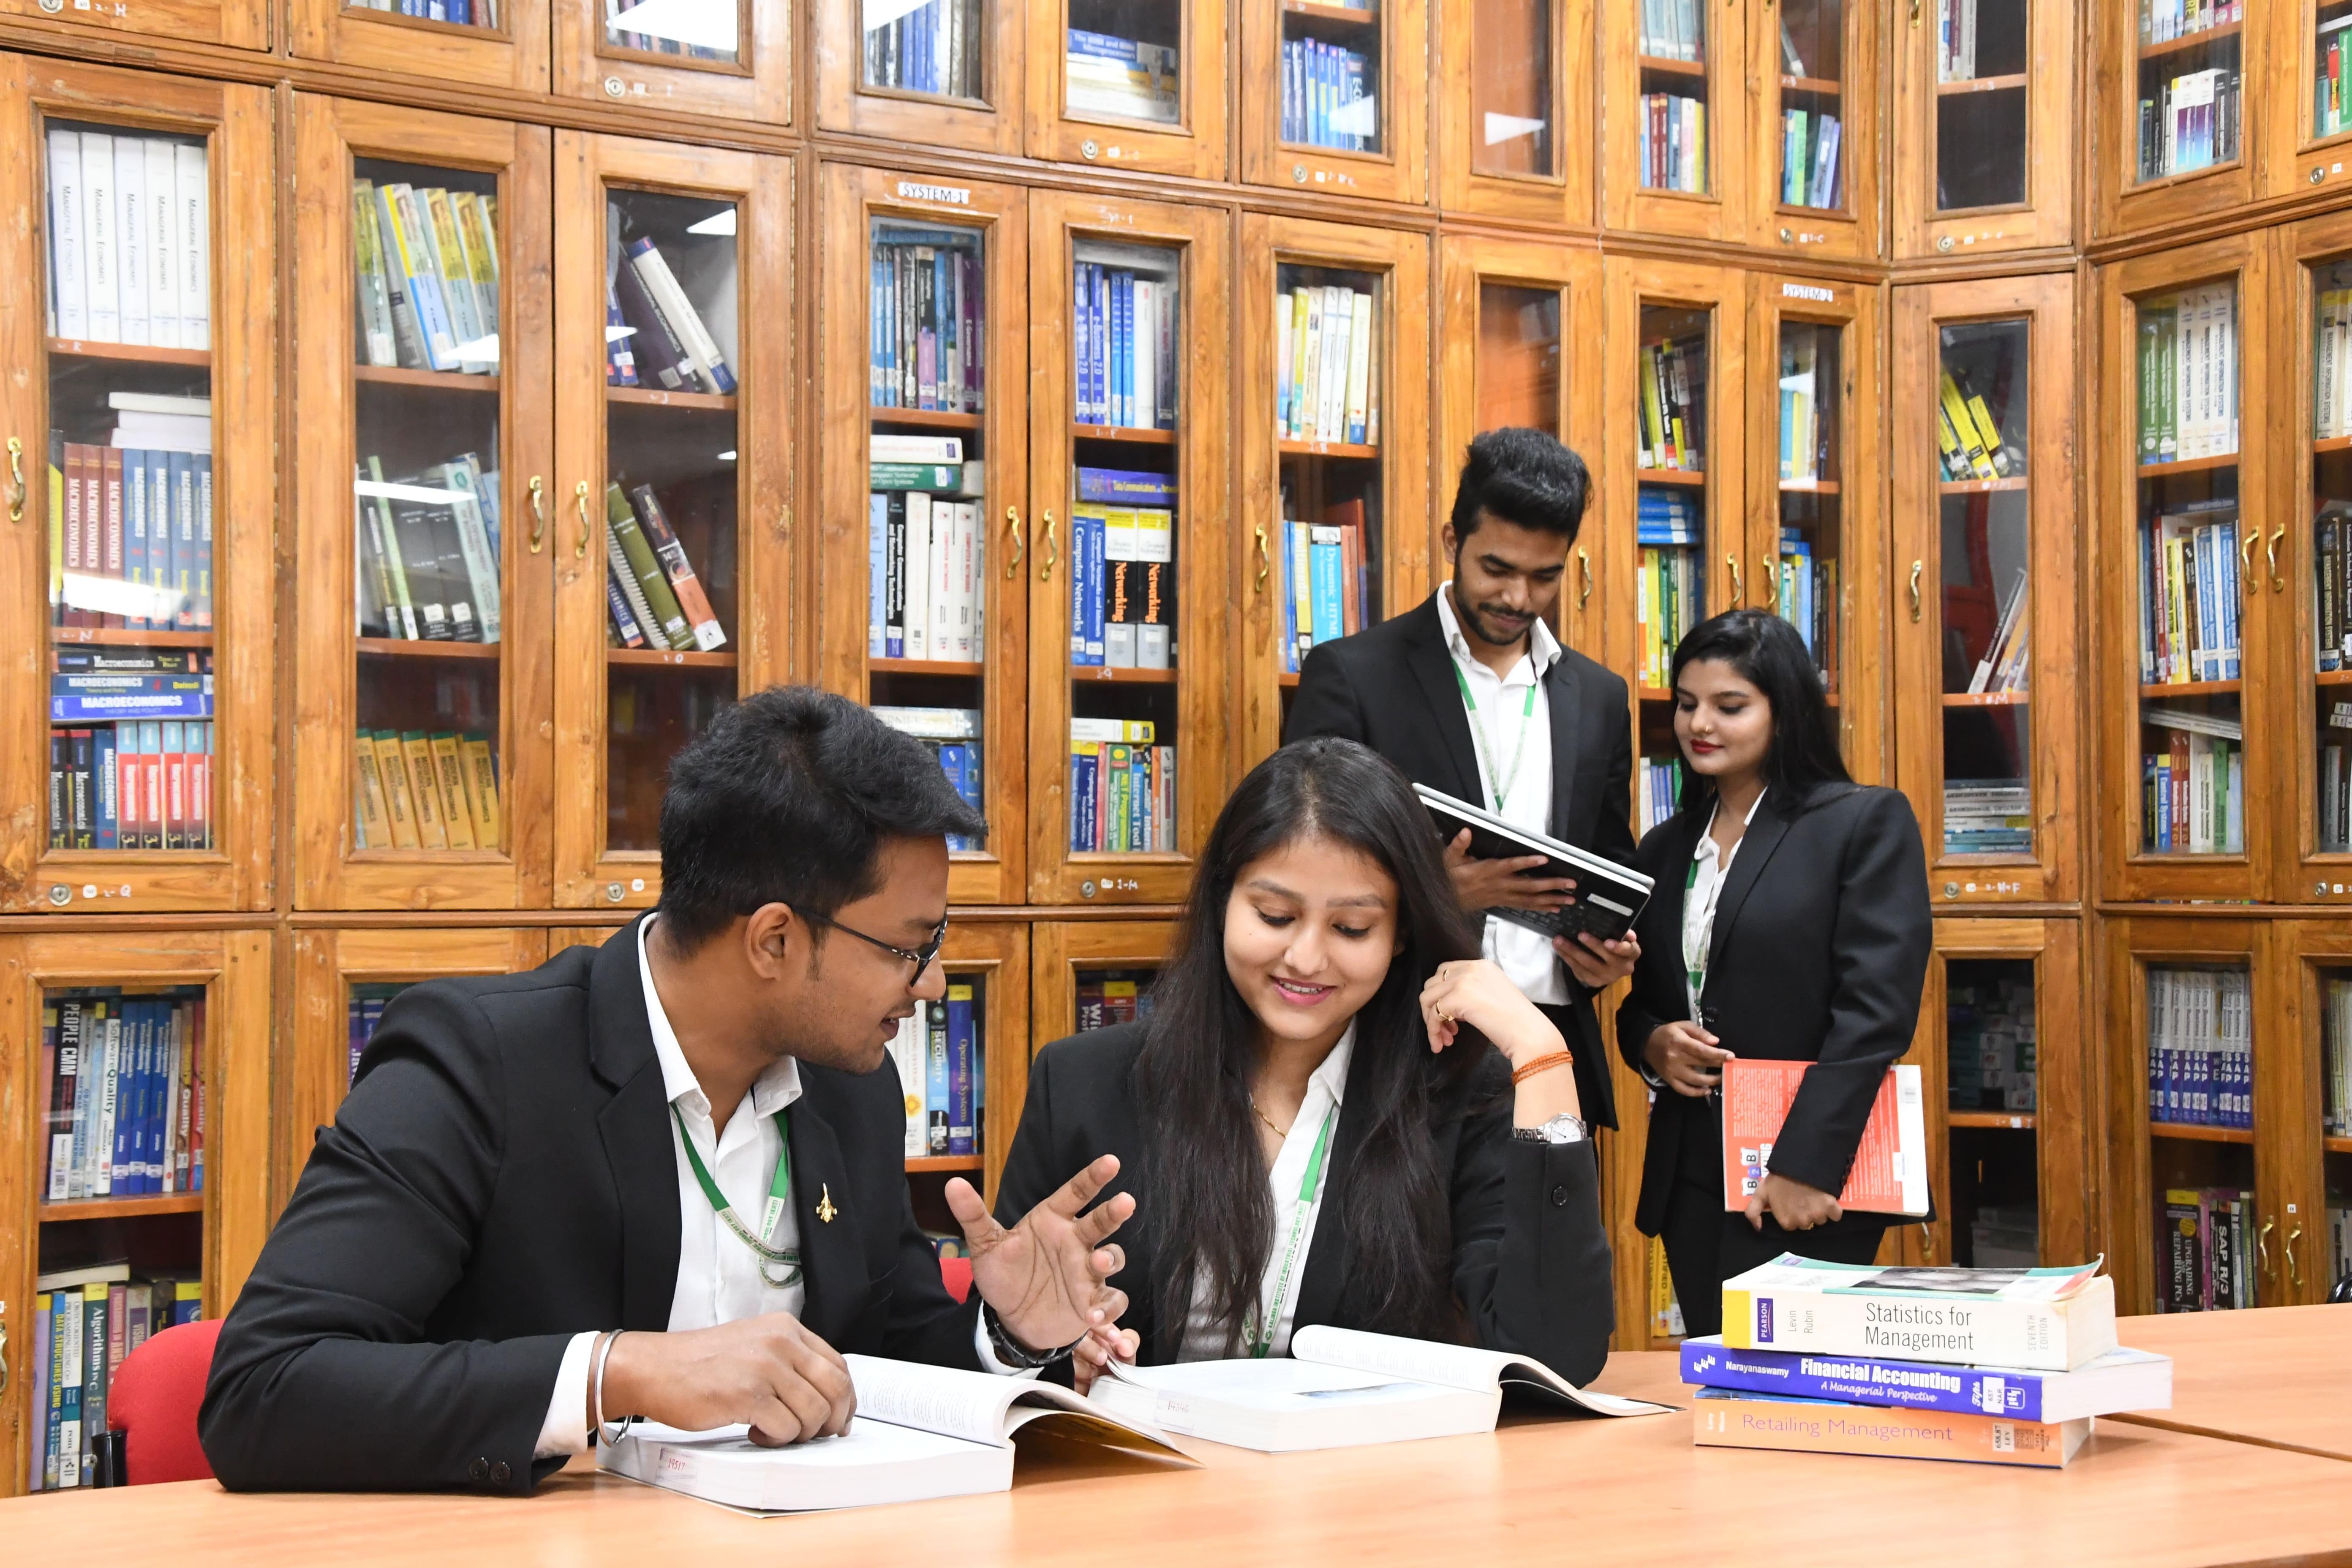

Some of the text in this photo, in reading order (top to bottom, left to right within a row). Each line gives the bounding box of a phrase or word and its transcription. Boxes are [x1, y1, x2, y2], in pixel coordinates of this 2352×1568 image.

[903, 184, 964, 202] SYSTEM-1
[68, 478, 80, 567] MACROECONOMICS
[87, 479, 99, 568] MACROECONOMICS
[109, 481, 120, 569] MACROECONOMICS
[1073, 527, 1085, 632] Computer Networks
[1326, 547, 1337, 597] Dynamic
[1112, 562, 1128, 622] Networking
[1145, 562, 1161, 623] Networking
[69, 678, 143, 688] MACROECONOMICS
[81, 696, 183, 708] MACROECONOMICS
[104, 748, 115, 819] MACROECONOMICS
[1132, 773, 1142, 845] Internet Tool
[62, 1004, 81, 1043] PEOPLE
[60, 1047, 77, 1075] CMM
[104, 1023, 120, 1114] Software Quality
[958, 1039, 968, 1122] Operating Systems
[762, 1216, 773, 1242] CHNOLOGY
[1268, 1308, 1277, 1328] KALINGA
[1273, 1283, 1285, 1307] INSTITUTE
[1281, 1248, 1293, 1274] INDUSTRIAL
[1289, 1216, 1301, 1246] TECHNOLOGY
[2173, 1231, 2182, 1301] REPAIRING PCs
[2185, 1239, 2193, 1295] UPGRADING
[2219, 1225, 2229, 1294] SAP R/3
[55, 1314, 65, 1332] DATA
[1788, 1311, 1797, 1332] Levin
[1804, 1310, 1813, 1334] Rubin
[1866, 1302, 1972, 1326] Statistics for
[90, 1307, 105, 1371] Algorithms
[1865, 1326, 1974, 1351] Management
[2040, 1318, 2048, 1349] EDITION
[52, 1335, 64, 1383] STRUCTURES
[1726, 1361, 1789, 1378] Narayanaswamy
[1801, 1358, 1960, 1394] Financial Accounting
[52, 1385, 61, 1408] USING
[89, 1382, 98, 1391] C
[1821, 1381, 1938, 1403] A Managerial Perspective
[1971, 1381, 1984, 1407] Fifth
[1743, 1414, 1953, 1441] Retailing Management
[668, 1457, 686, 1470] 19517
